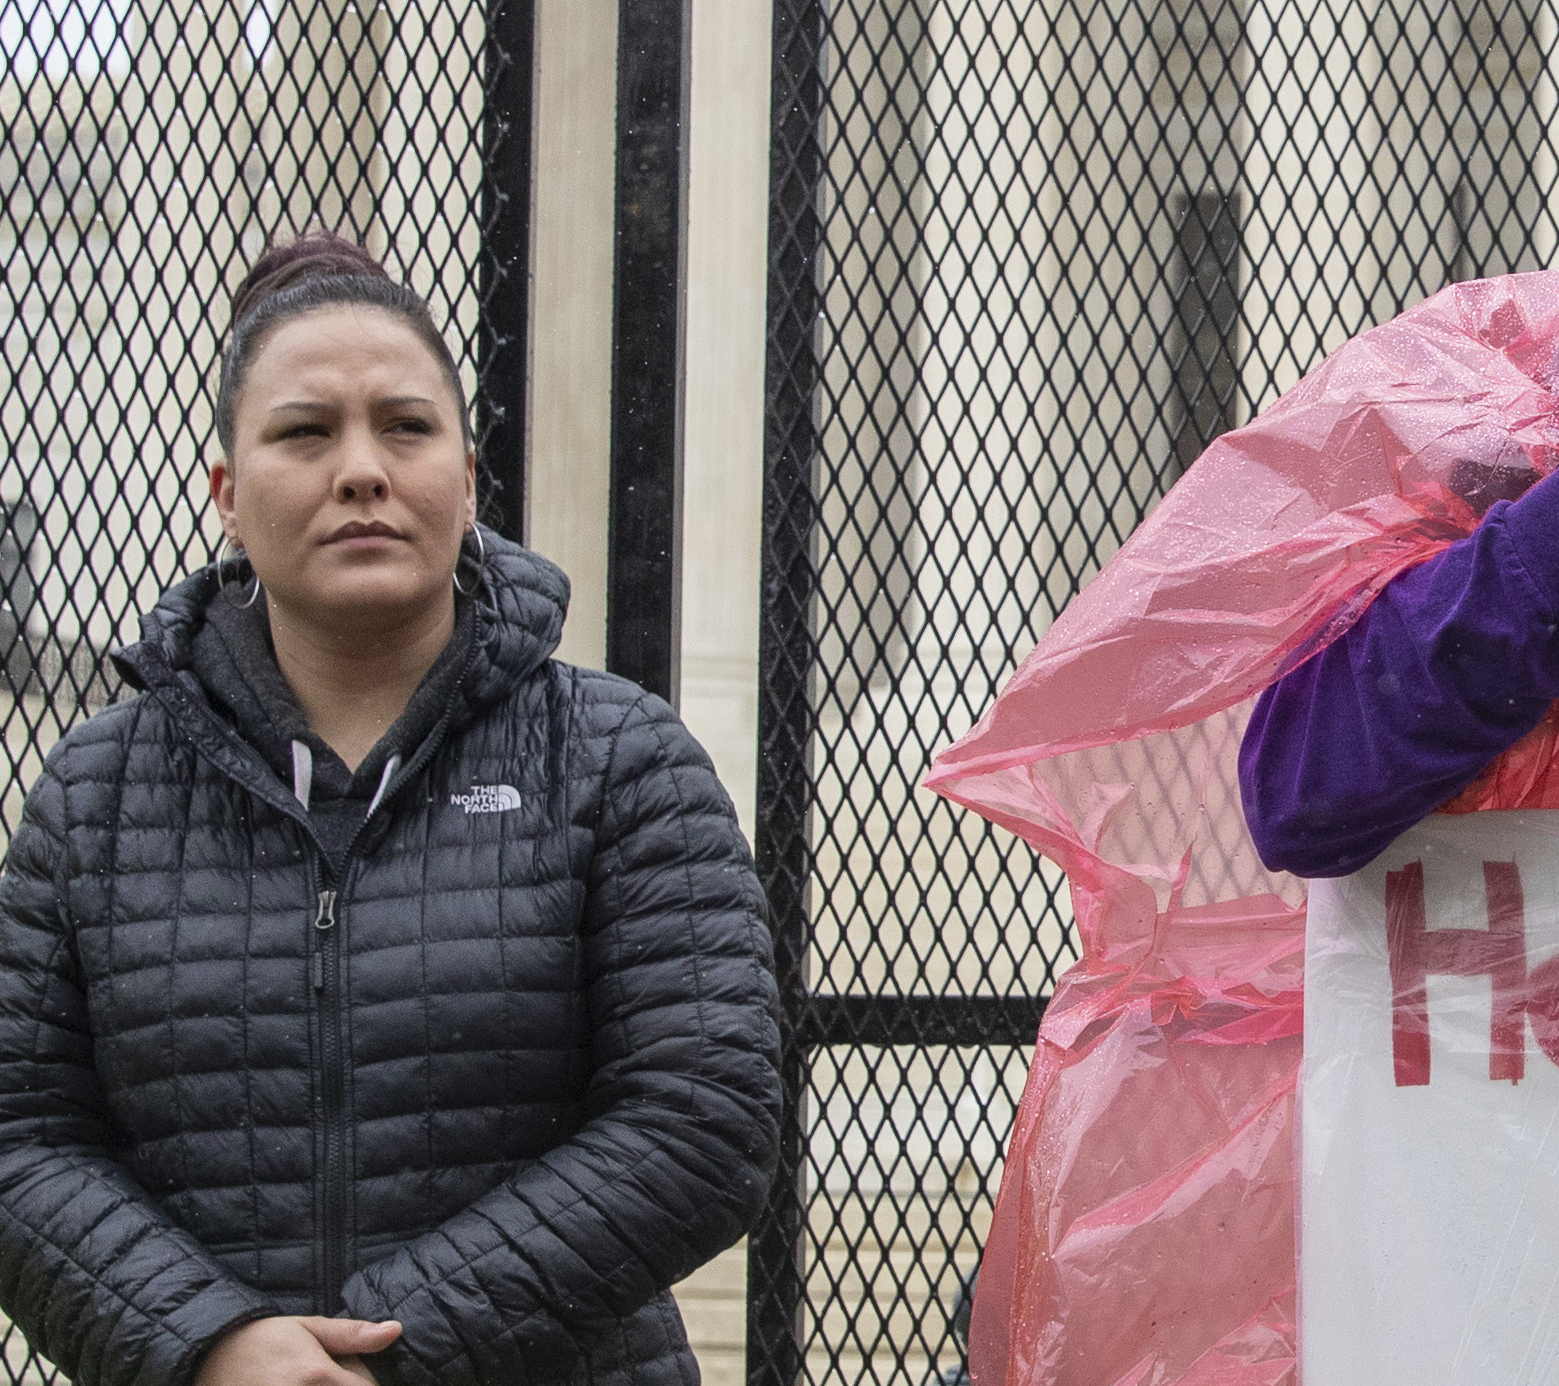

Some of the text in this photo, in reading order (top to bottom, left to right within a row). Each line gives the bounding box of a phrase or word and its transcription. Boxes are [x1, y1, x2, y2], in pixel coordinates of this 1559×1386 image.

[471, 785, 498, 795] THE
[451, 794, 499, 805] NORTH
[464, 804, 499, 814] FACE
